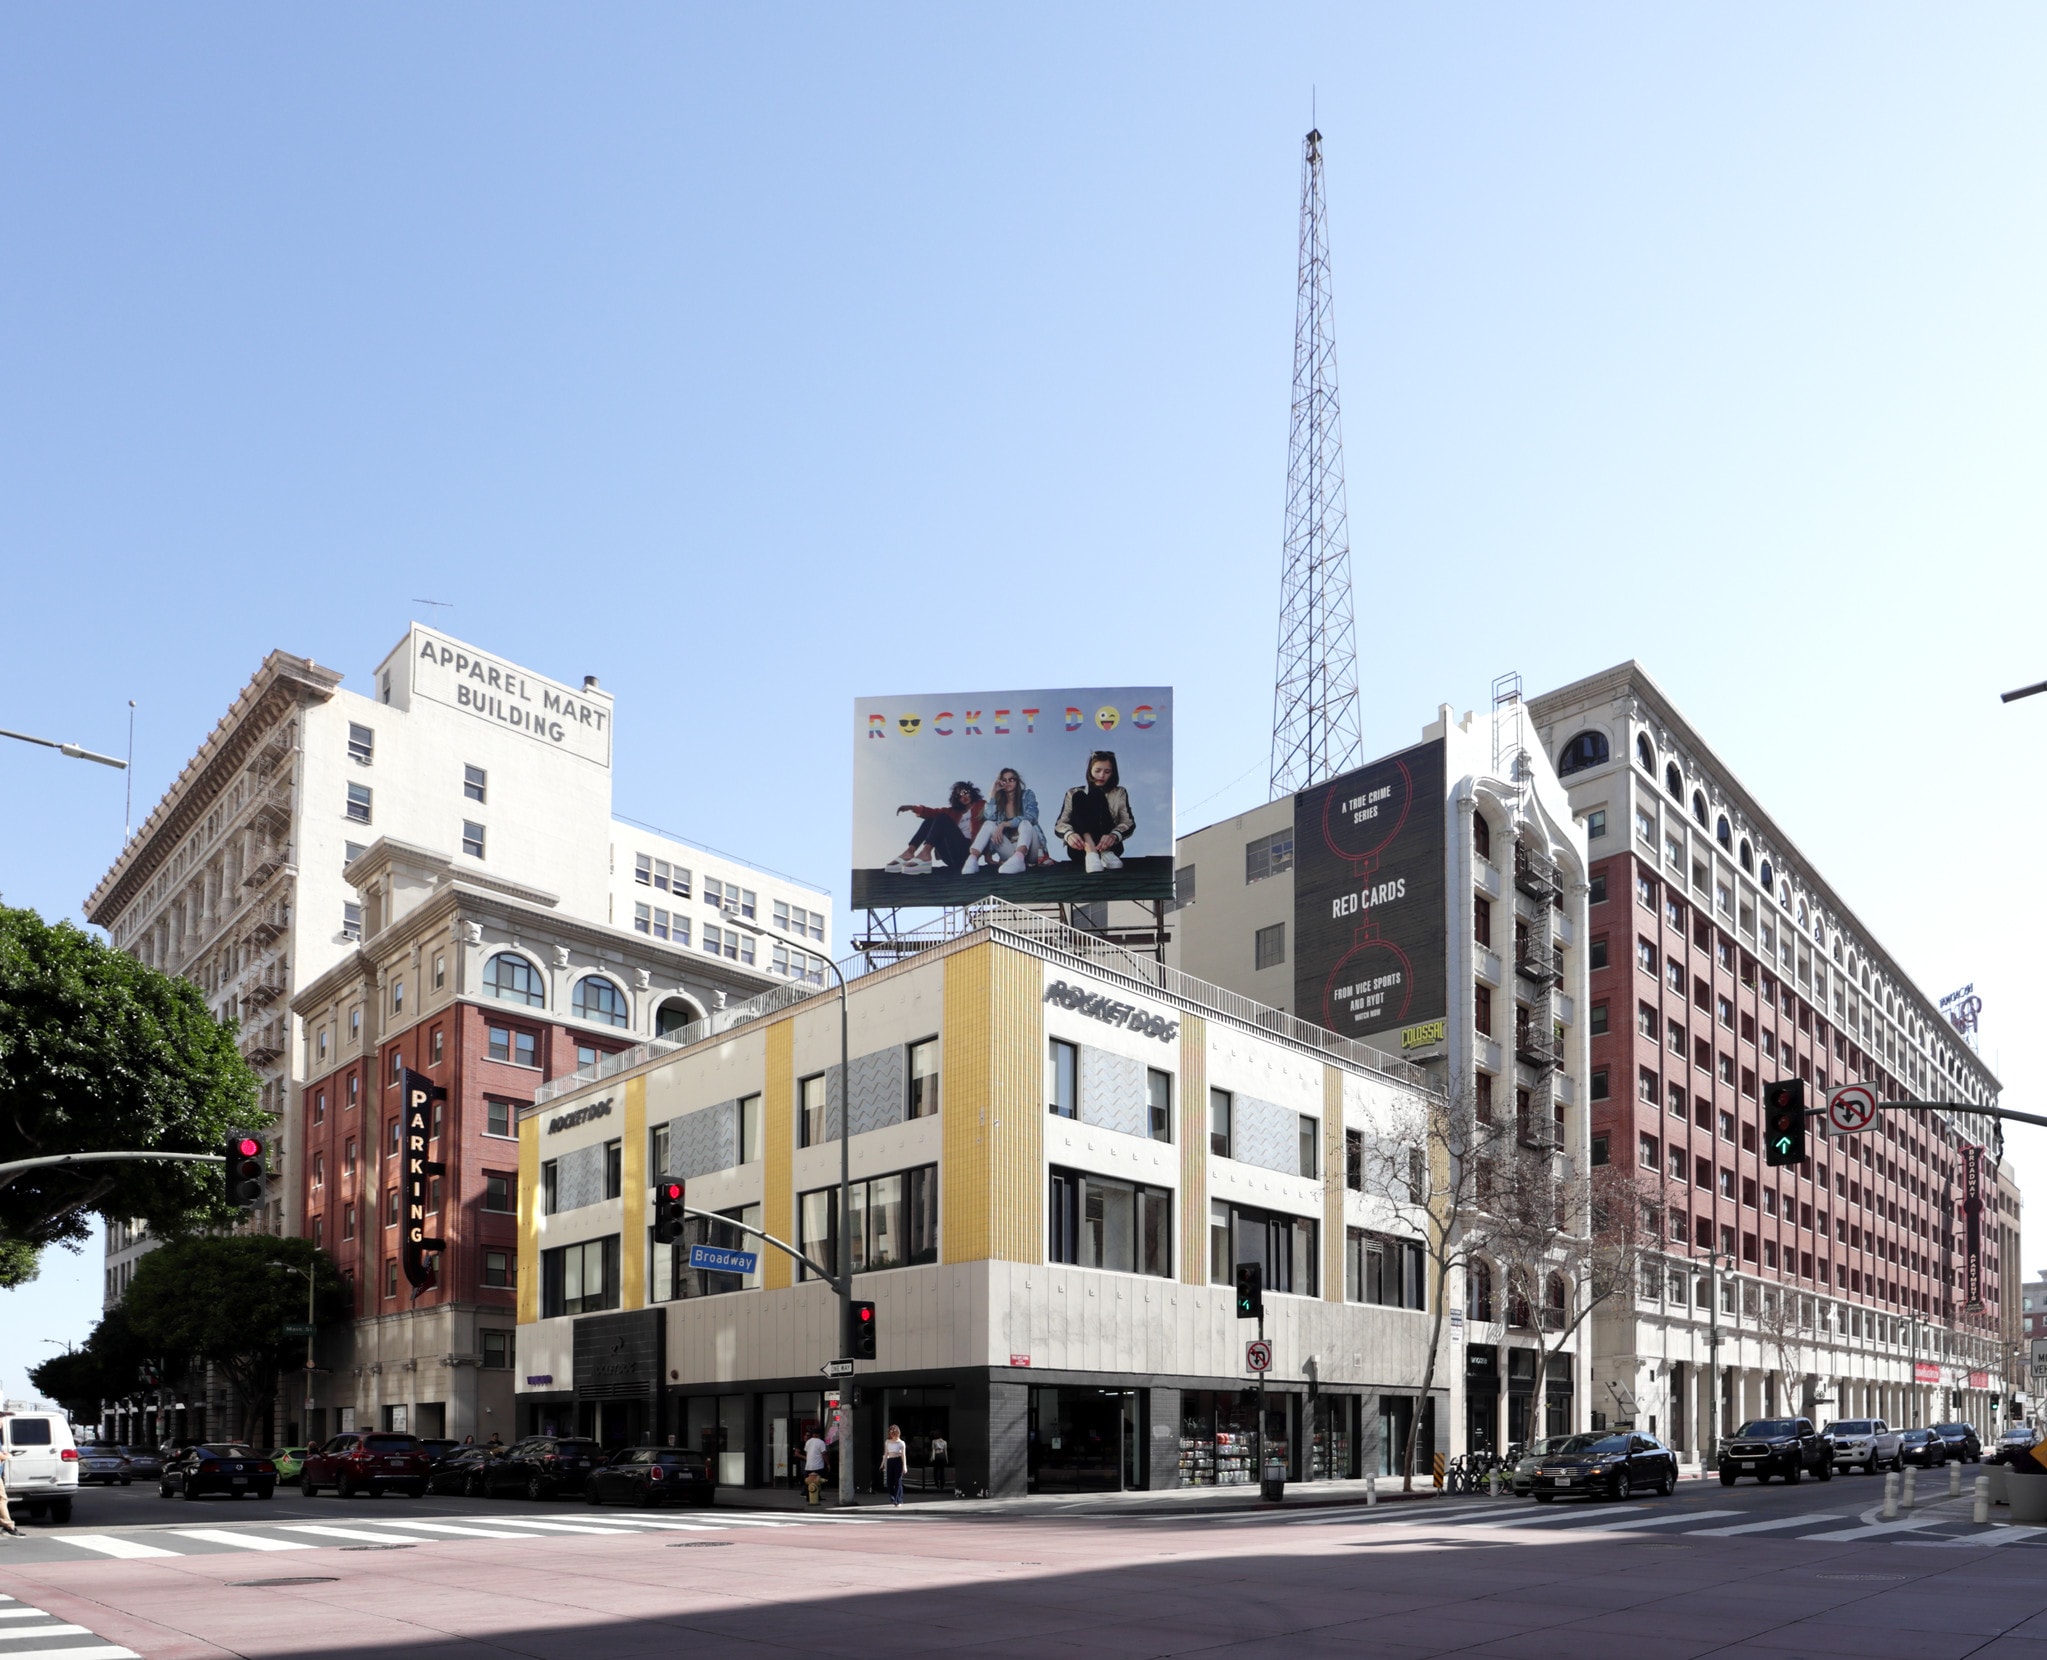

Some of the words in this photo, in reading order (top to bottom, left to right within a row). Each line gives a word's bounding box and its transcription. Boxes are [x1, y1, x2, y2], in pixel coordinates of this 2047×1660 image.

[420, 640, 531, 702] APPAREL
[544, 689, 606, 731] MART
[458, 684, 565, 742] BUILDING
[1341, 802, 1347, 814] A
[1349, 794, 1366, 811] TRUE
[1368, 785, 1391, 804] CRIME
[1353, 805, 1378, 824] SERIES
[1332, 892, 1358, 918] RED
[1361, 878, 1406, 910] CARDS
[1334, 985, 1353, 1001] FROM
[1355, 980, 1371, 995] VICE
[1373, 972, 1401, 990] SPORTS
[1350, 997, 1364, 1012] AND
[1366, 992, 1384, 1007] RYOT
[1401, 1021, 1444, 1048] COLOSSAL
[410, 1090, 427, 1243] PARKING
[1968, 1149, 1976, 1198] BROADWAY
[695, 1249, 752, 1269] Broadway
[831, 1365, 840, 1373] ONE
[841, 1363, 851, 1373] WAY
